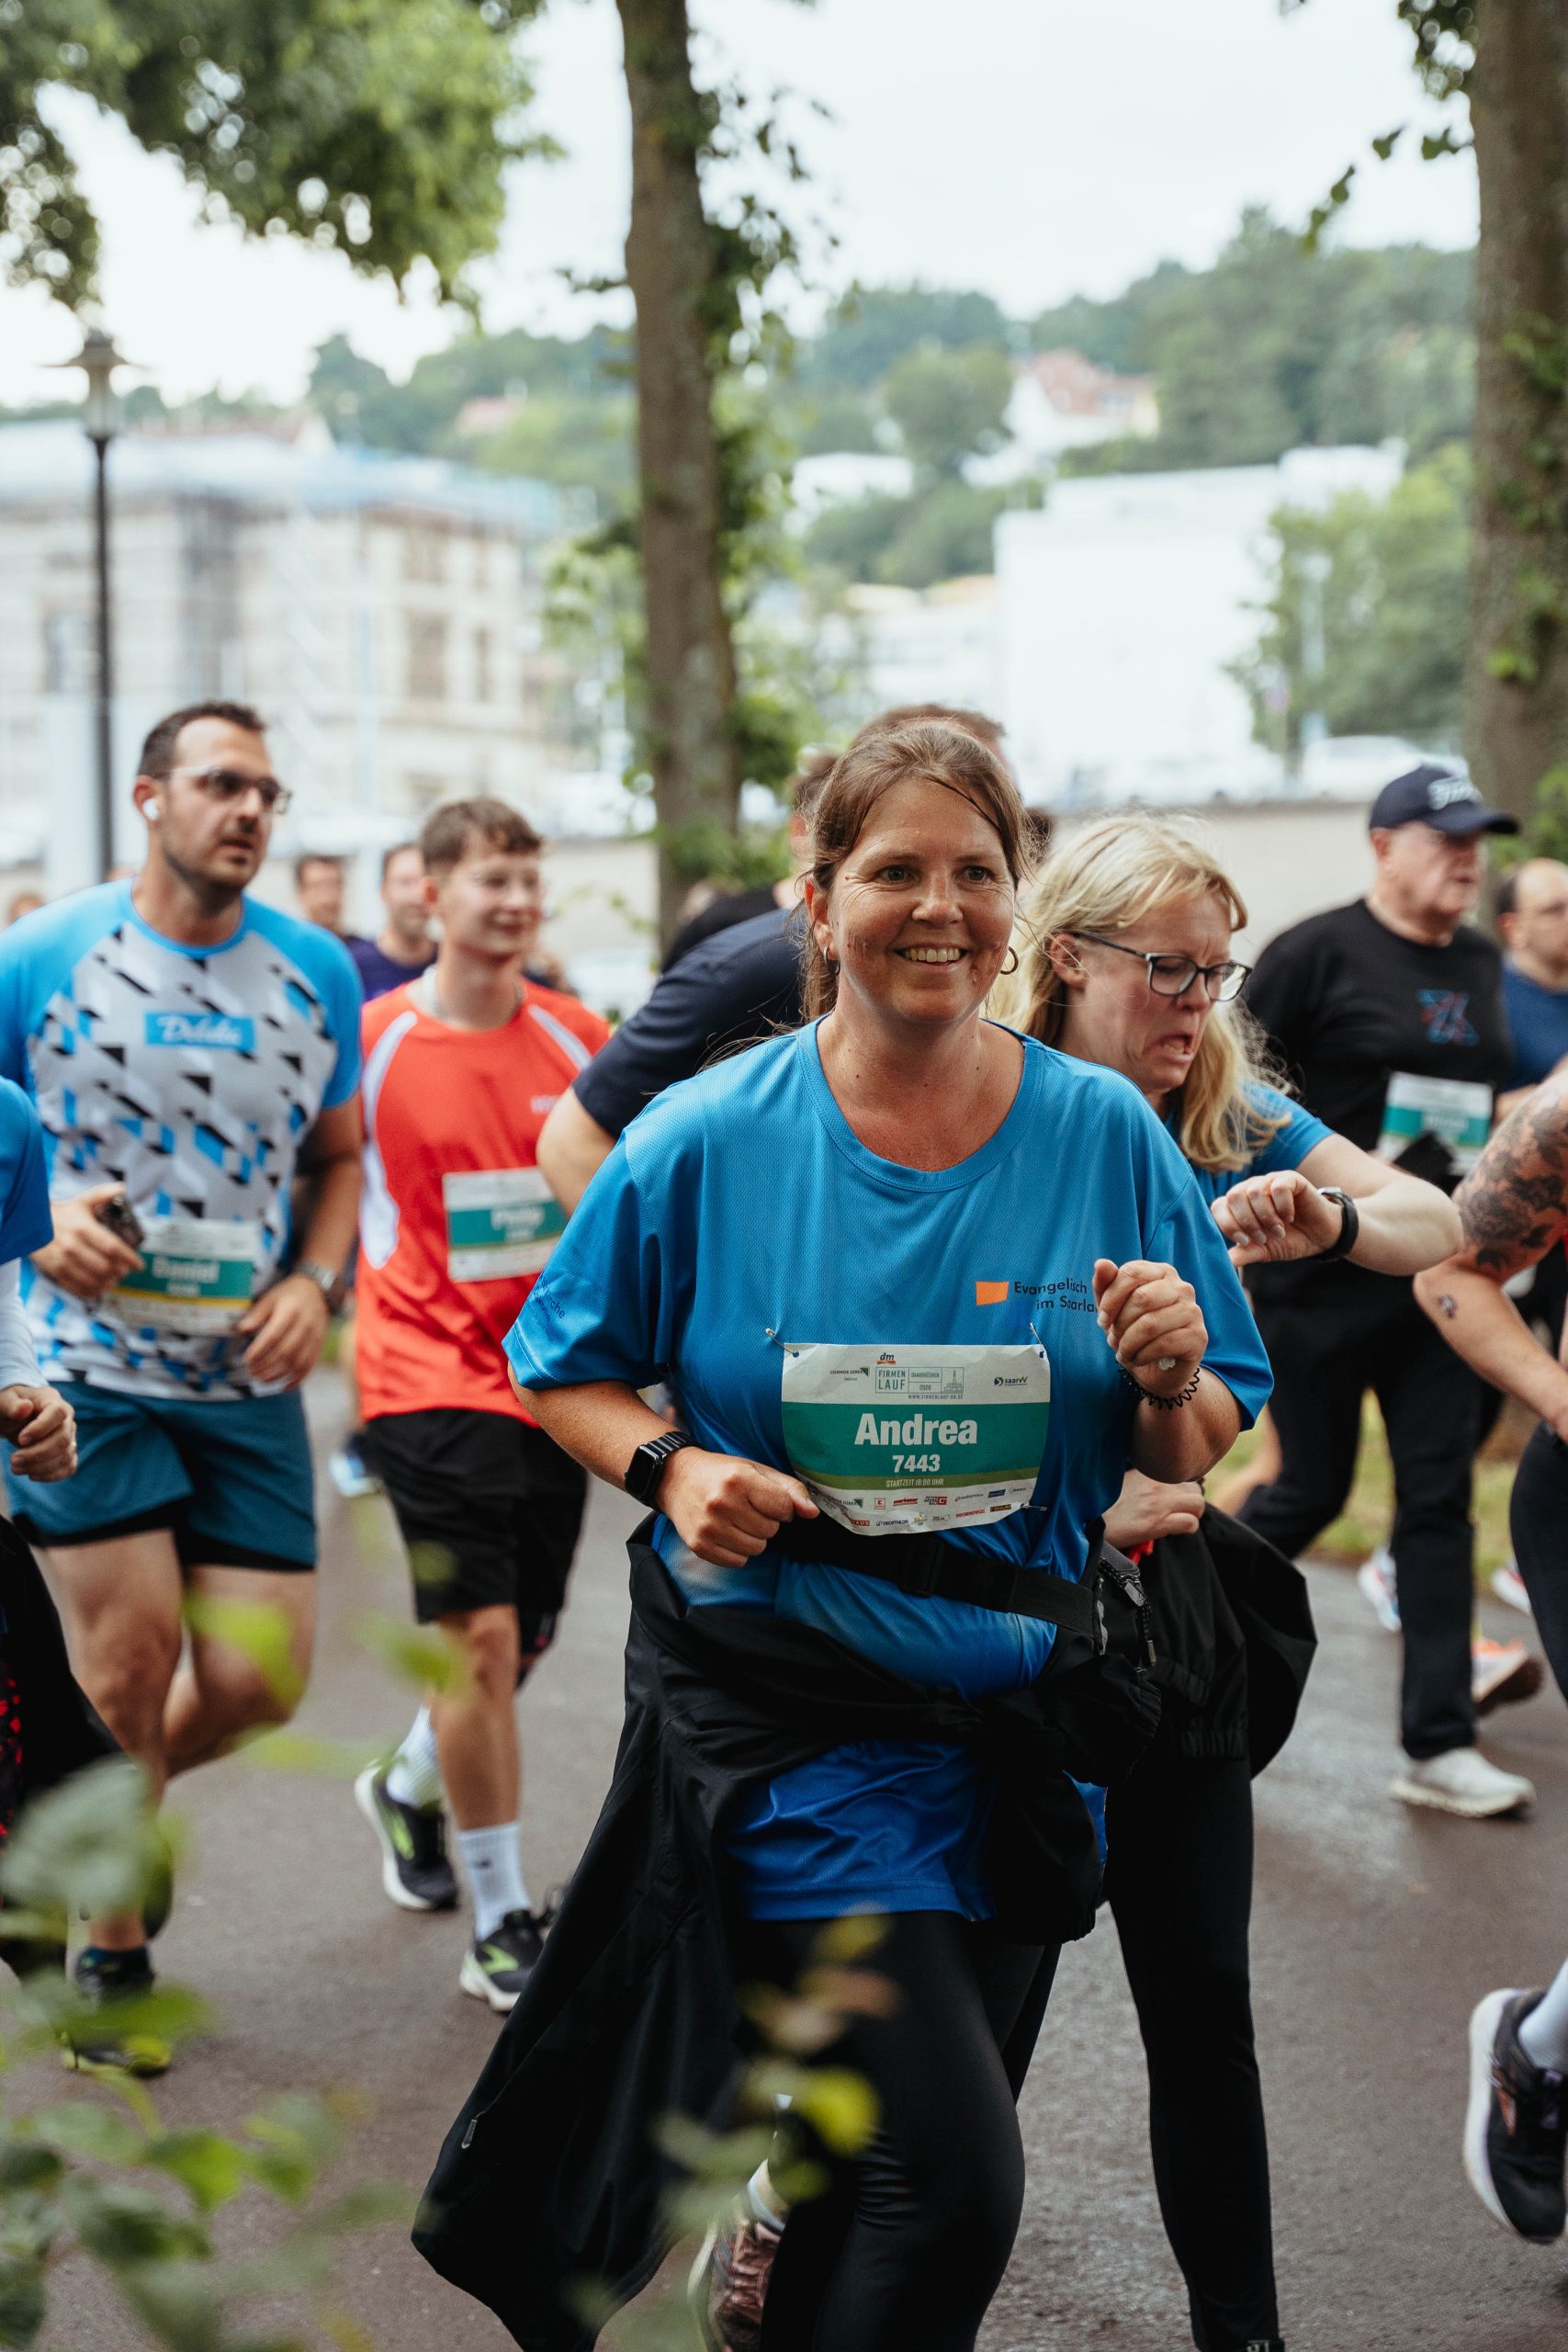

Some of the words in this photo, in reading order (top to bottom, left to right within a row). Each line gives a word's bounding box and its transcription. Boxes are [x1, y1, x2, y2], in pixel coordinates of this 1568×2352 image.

[1014, 1278, 1088, 1295] Evangelisch
[1036, 1299, 1055, 1309] im
[1060, 1295, 1099, 1313] Saarla
[880, 1352, 895, 1361] dm
[878, 1370, 906, 1378] FIRMEN
[878, 1379, 906, 1390] LAUF
[854, 1413, 977, 1445] Andrea
[892, 1454, 941, 1473] 7443
[886, 1478, 914, 1487] STARTZEIT
